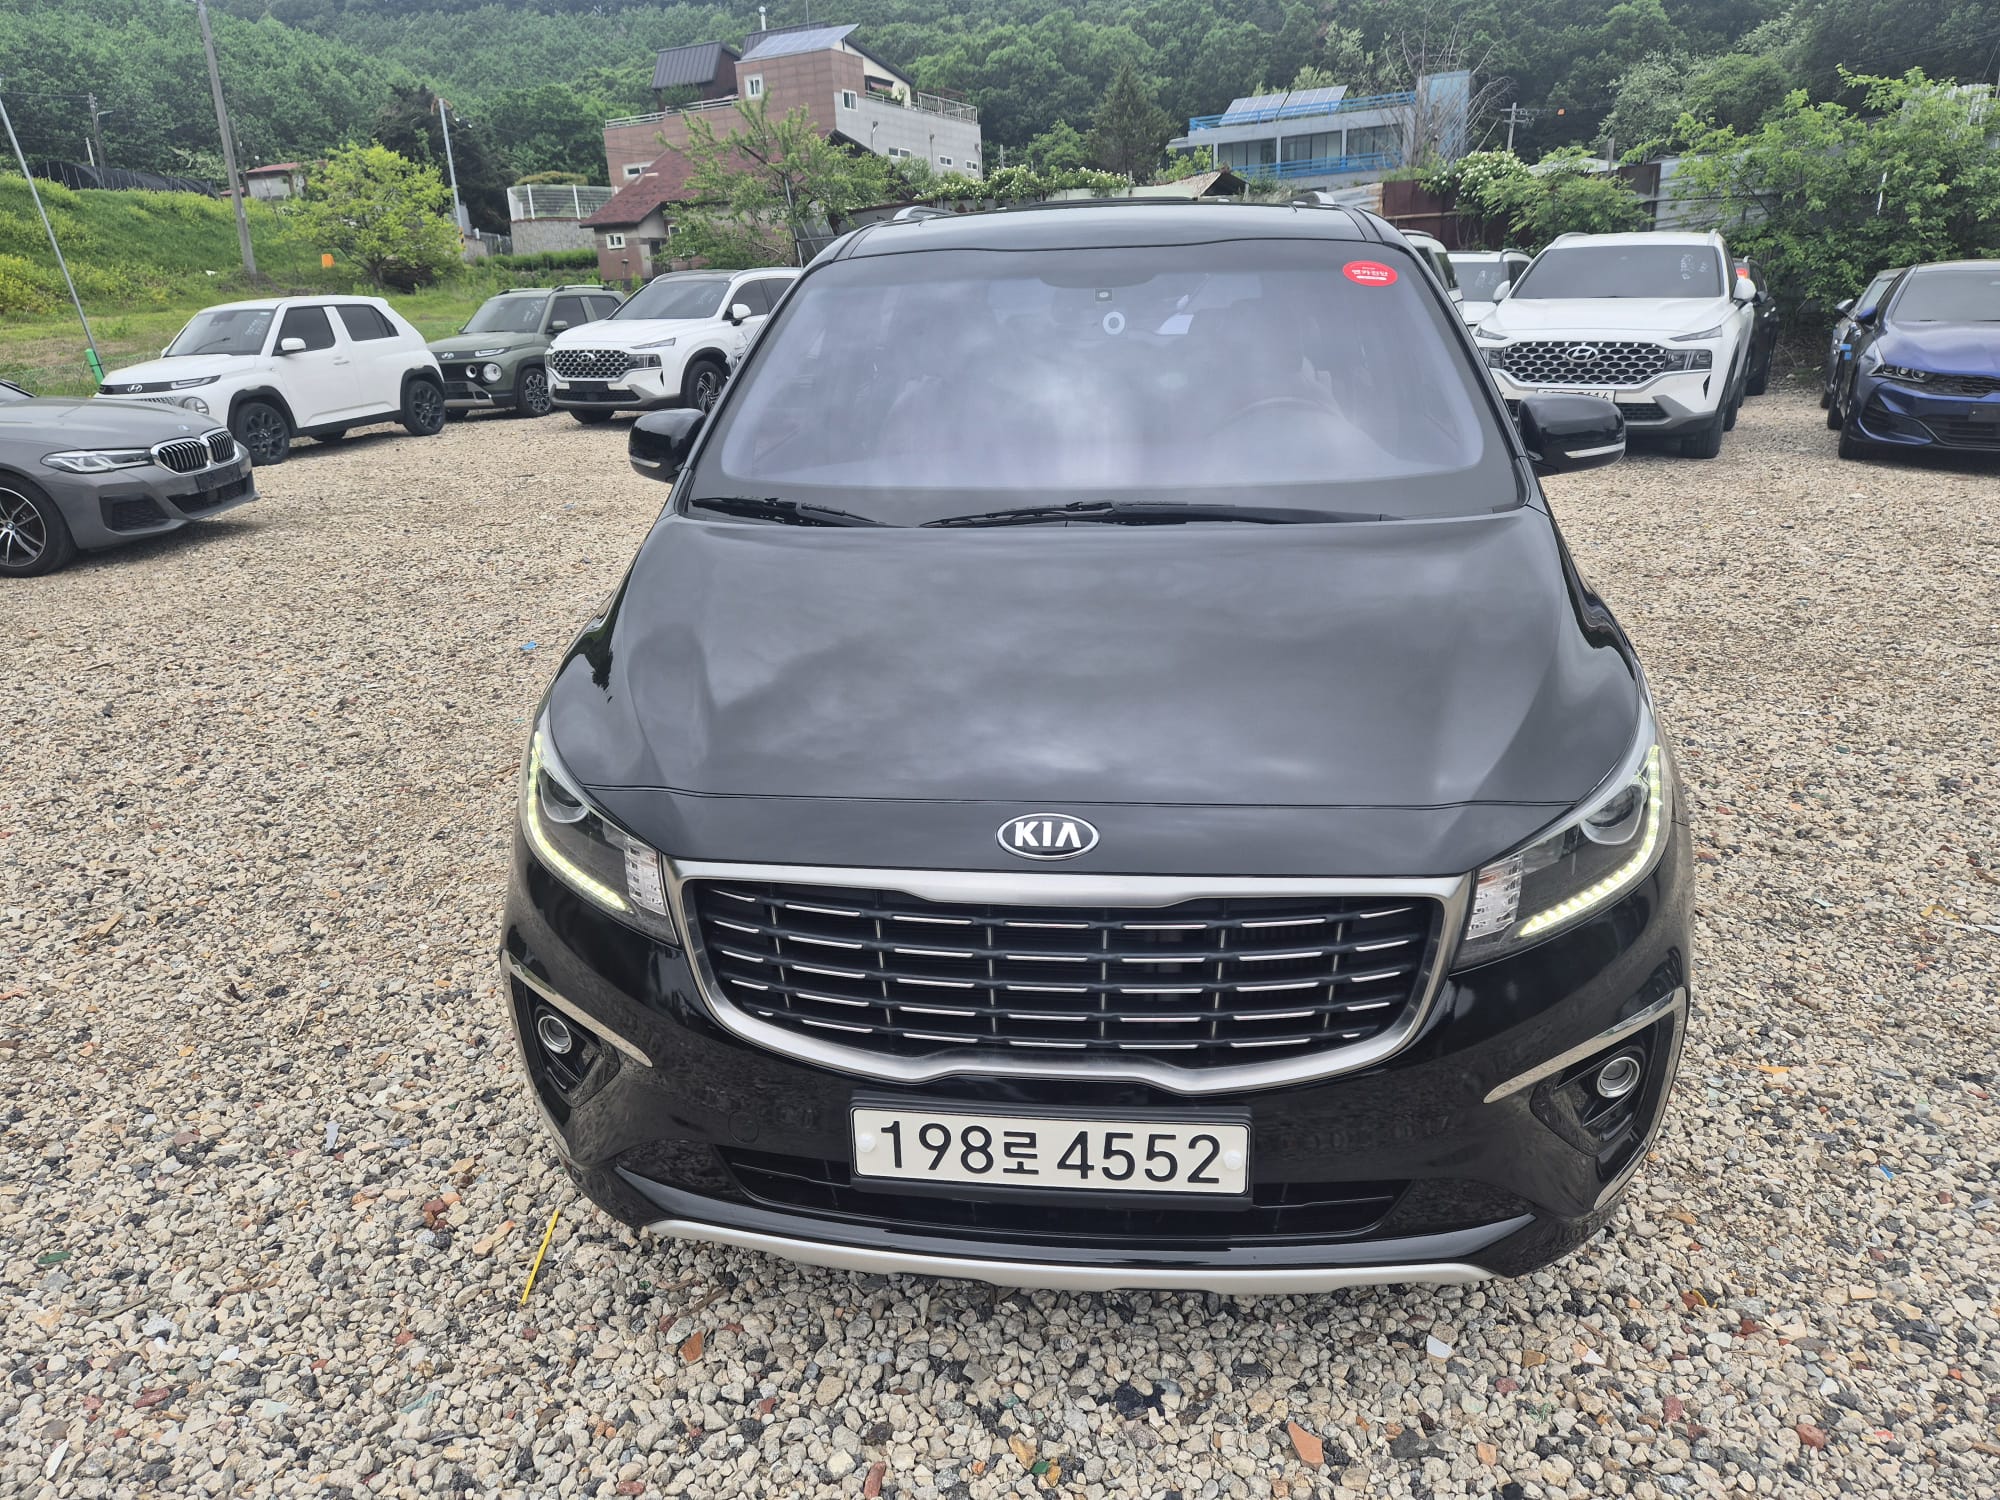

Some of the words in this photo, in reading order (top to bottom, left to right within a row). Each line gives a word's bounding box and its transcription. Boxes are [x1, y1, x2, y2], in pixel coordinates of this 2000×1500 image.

[1014, 821, 1082, 848] KIA
[880, 1120, 1039, 1175] 198로
[1056, 1131, 1221, 1184] 4552
